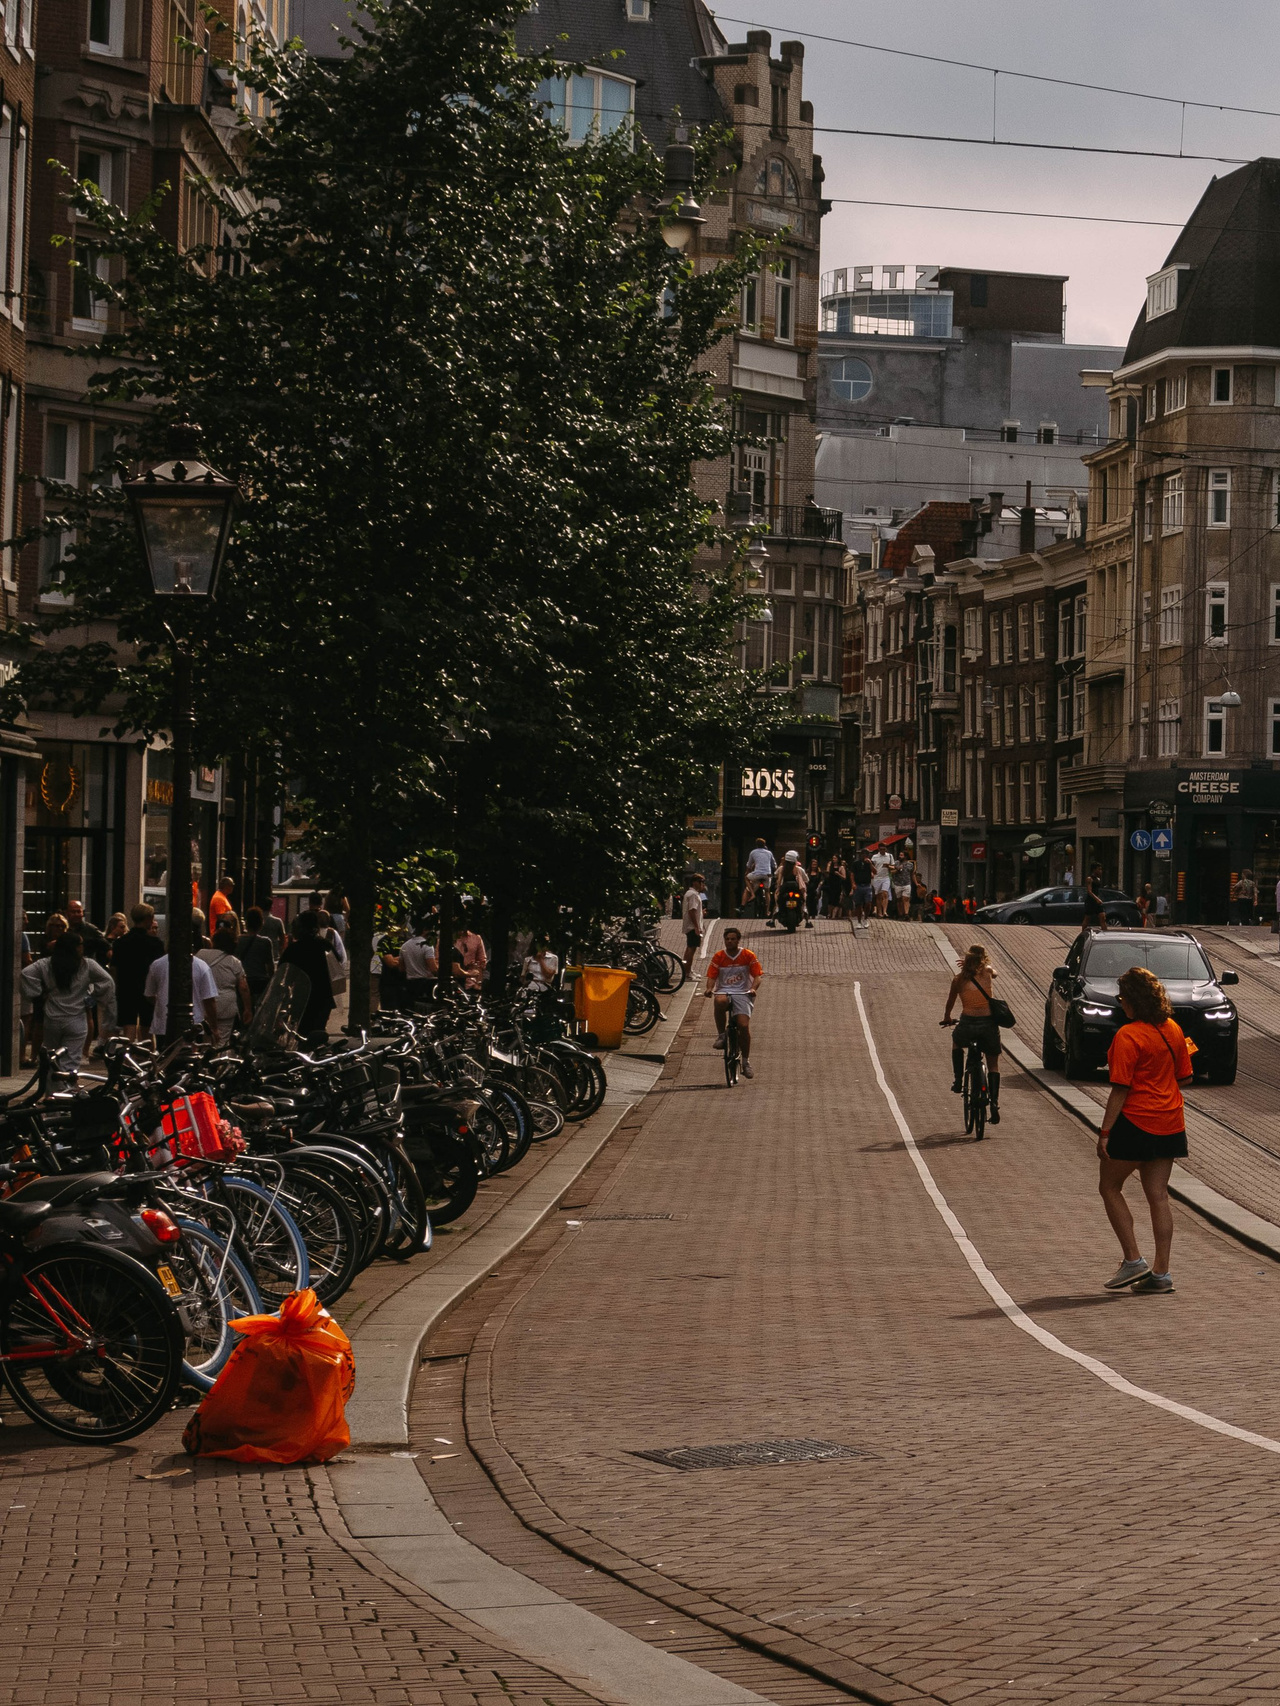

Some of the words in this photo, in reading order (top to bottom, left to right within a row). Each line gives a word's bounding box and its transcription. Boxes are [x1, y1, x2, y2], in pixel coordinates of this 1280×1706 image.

[833, 265, 940, 292] METZ
[1189, 772, 1230, 781] AMSTERDAM
[741, 767, 795, 799] BOSS
[1177, 782, 1240, 793] CHEESE
[1192, 794, 1224, 803] COMPANY
